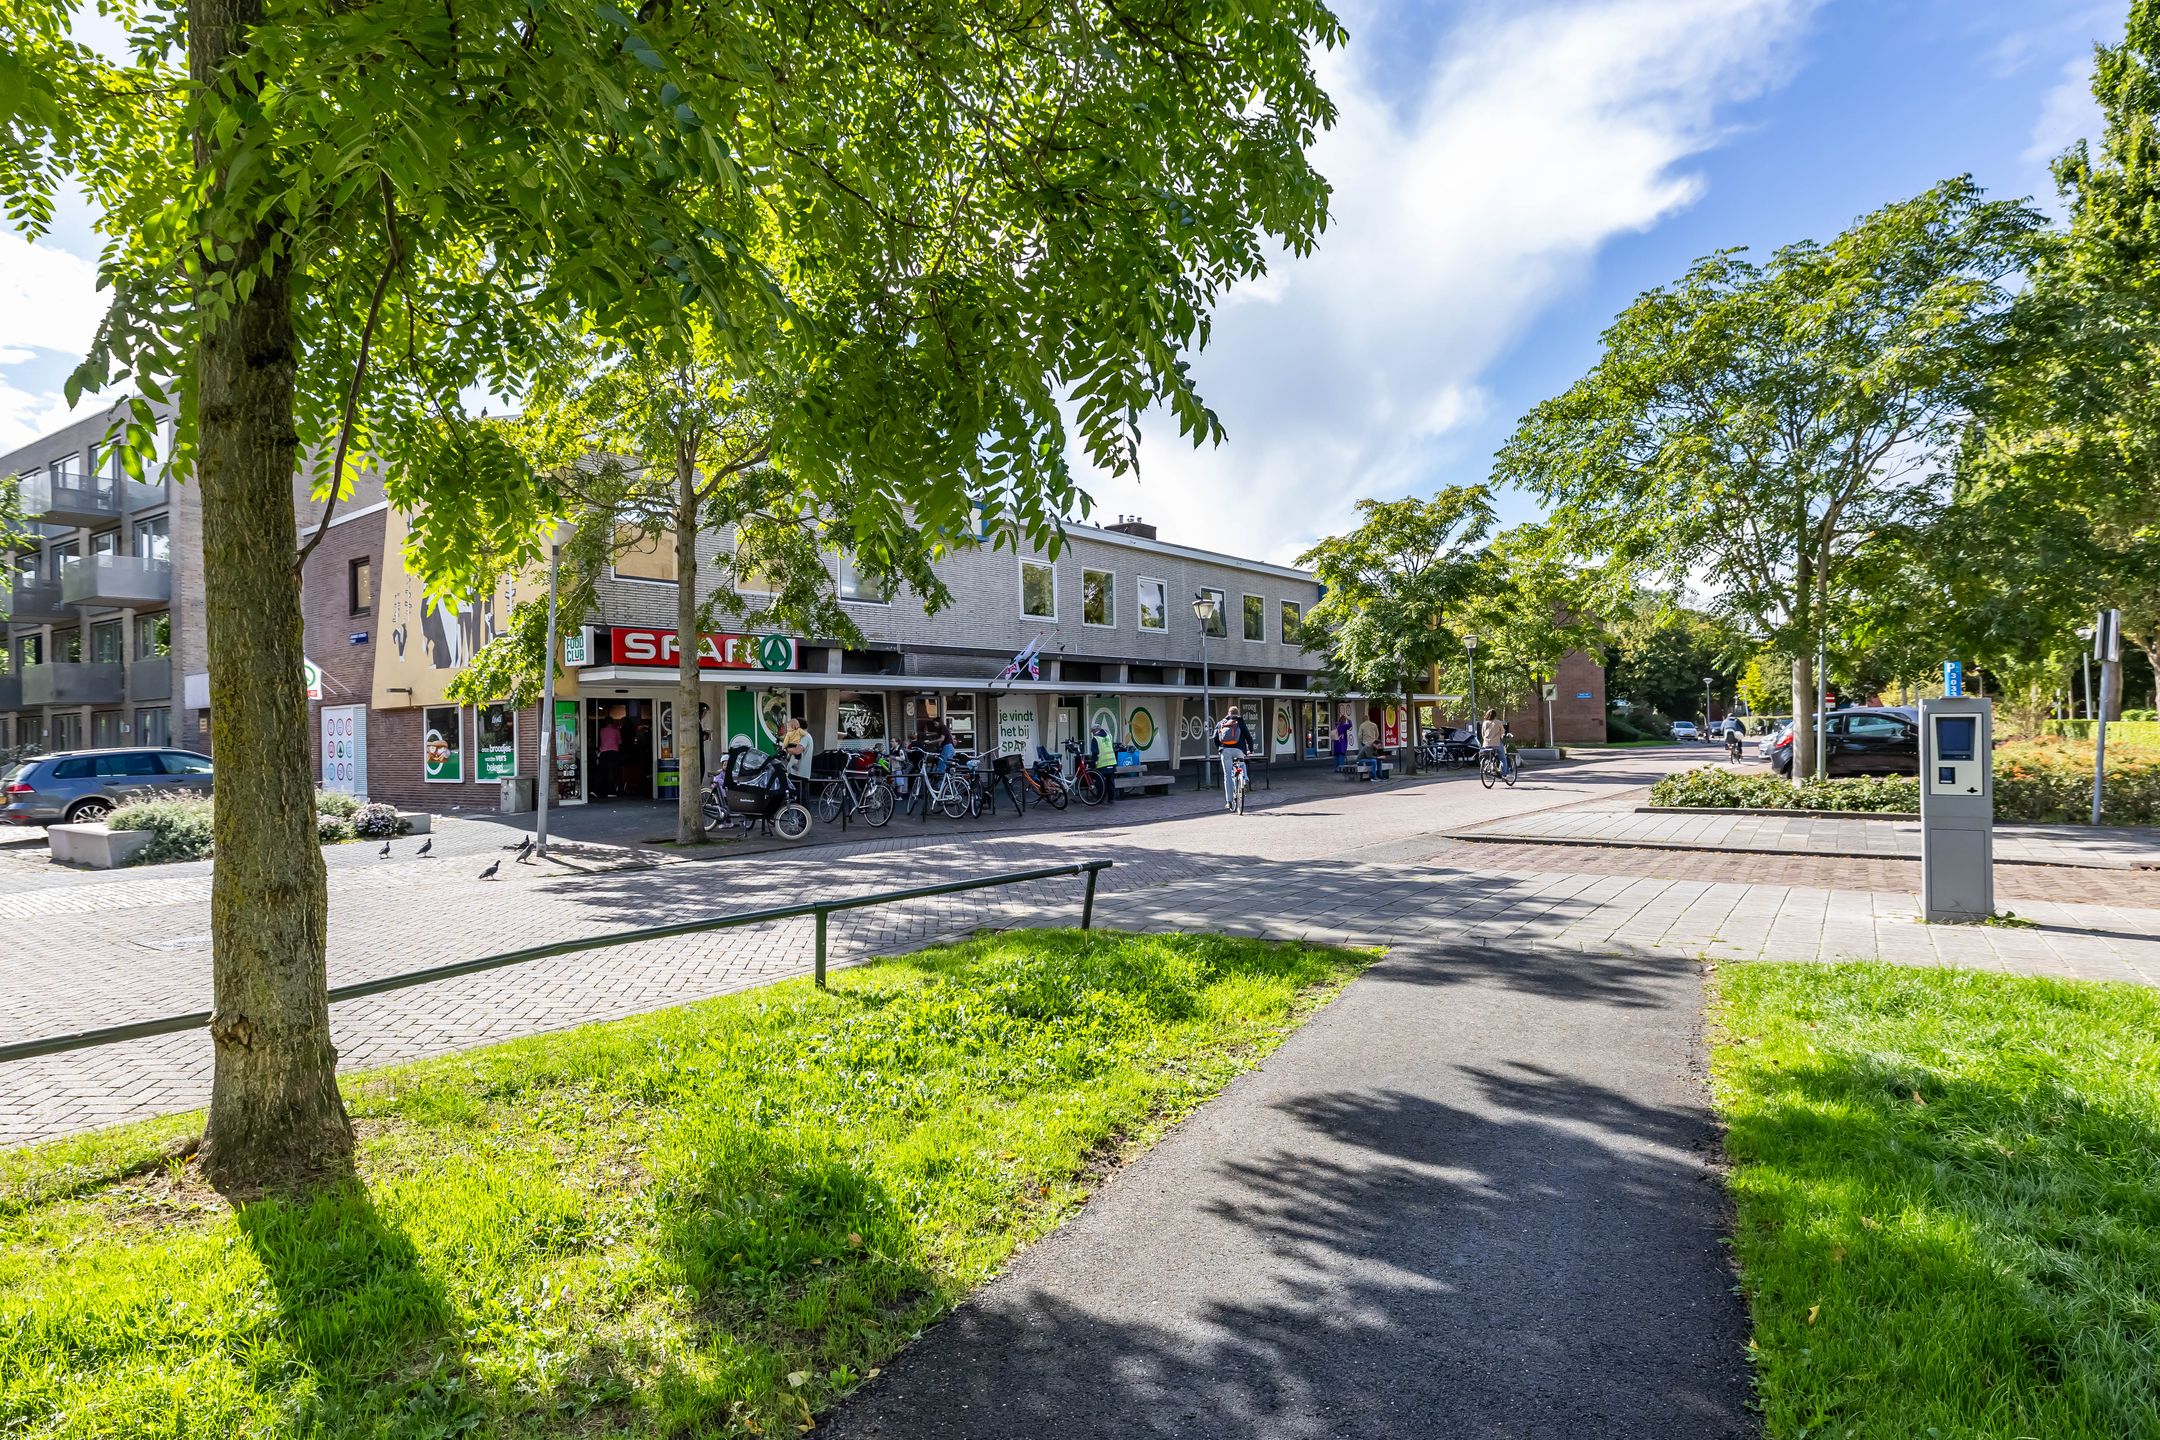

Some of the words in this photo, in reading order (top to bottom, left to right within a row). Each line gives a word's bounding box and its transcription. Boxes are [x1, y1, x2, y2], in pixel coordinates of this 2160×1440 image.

[567, 637, 584, 650] FOOD
[567, 649, 584, 662] CLUB
[1946, 662, 1956, 673] P
[999, 709, 1008, 724] je
[1009, 709, 1034, 722] vindt
[1000, 725, 1016, 737] het
[1018, 725, 1030, 739] bij
[489, 744, 511, 754] broodjes
